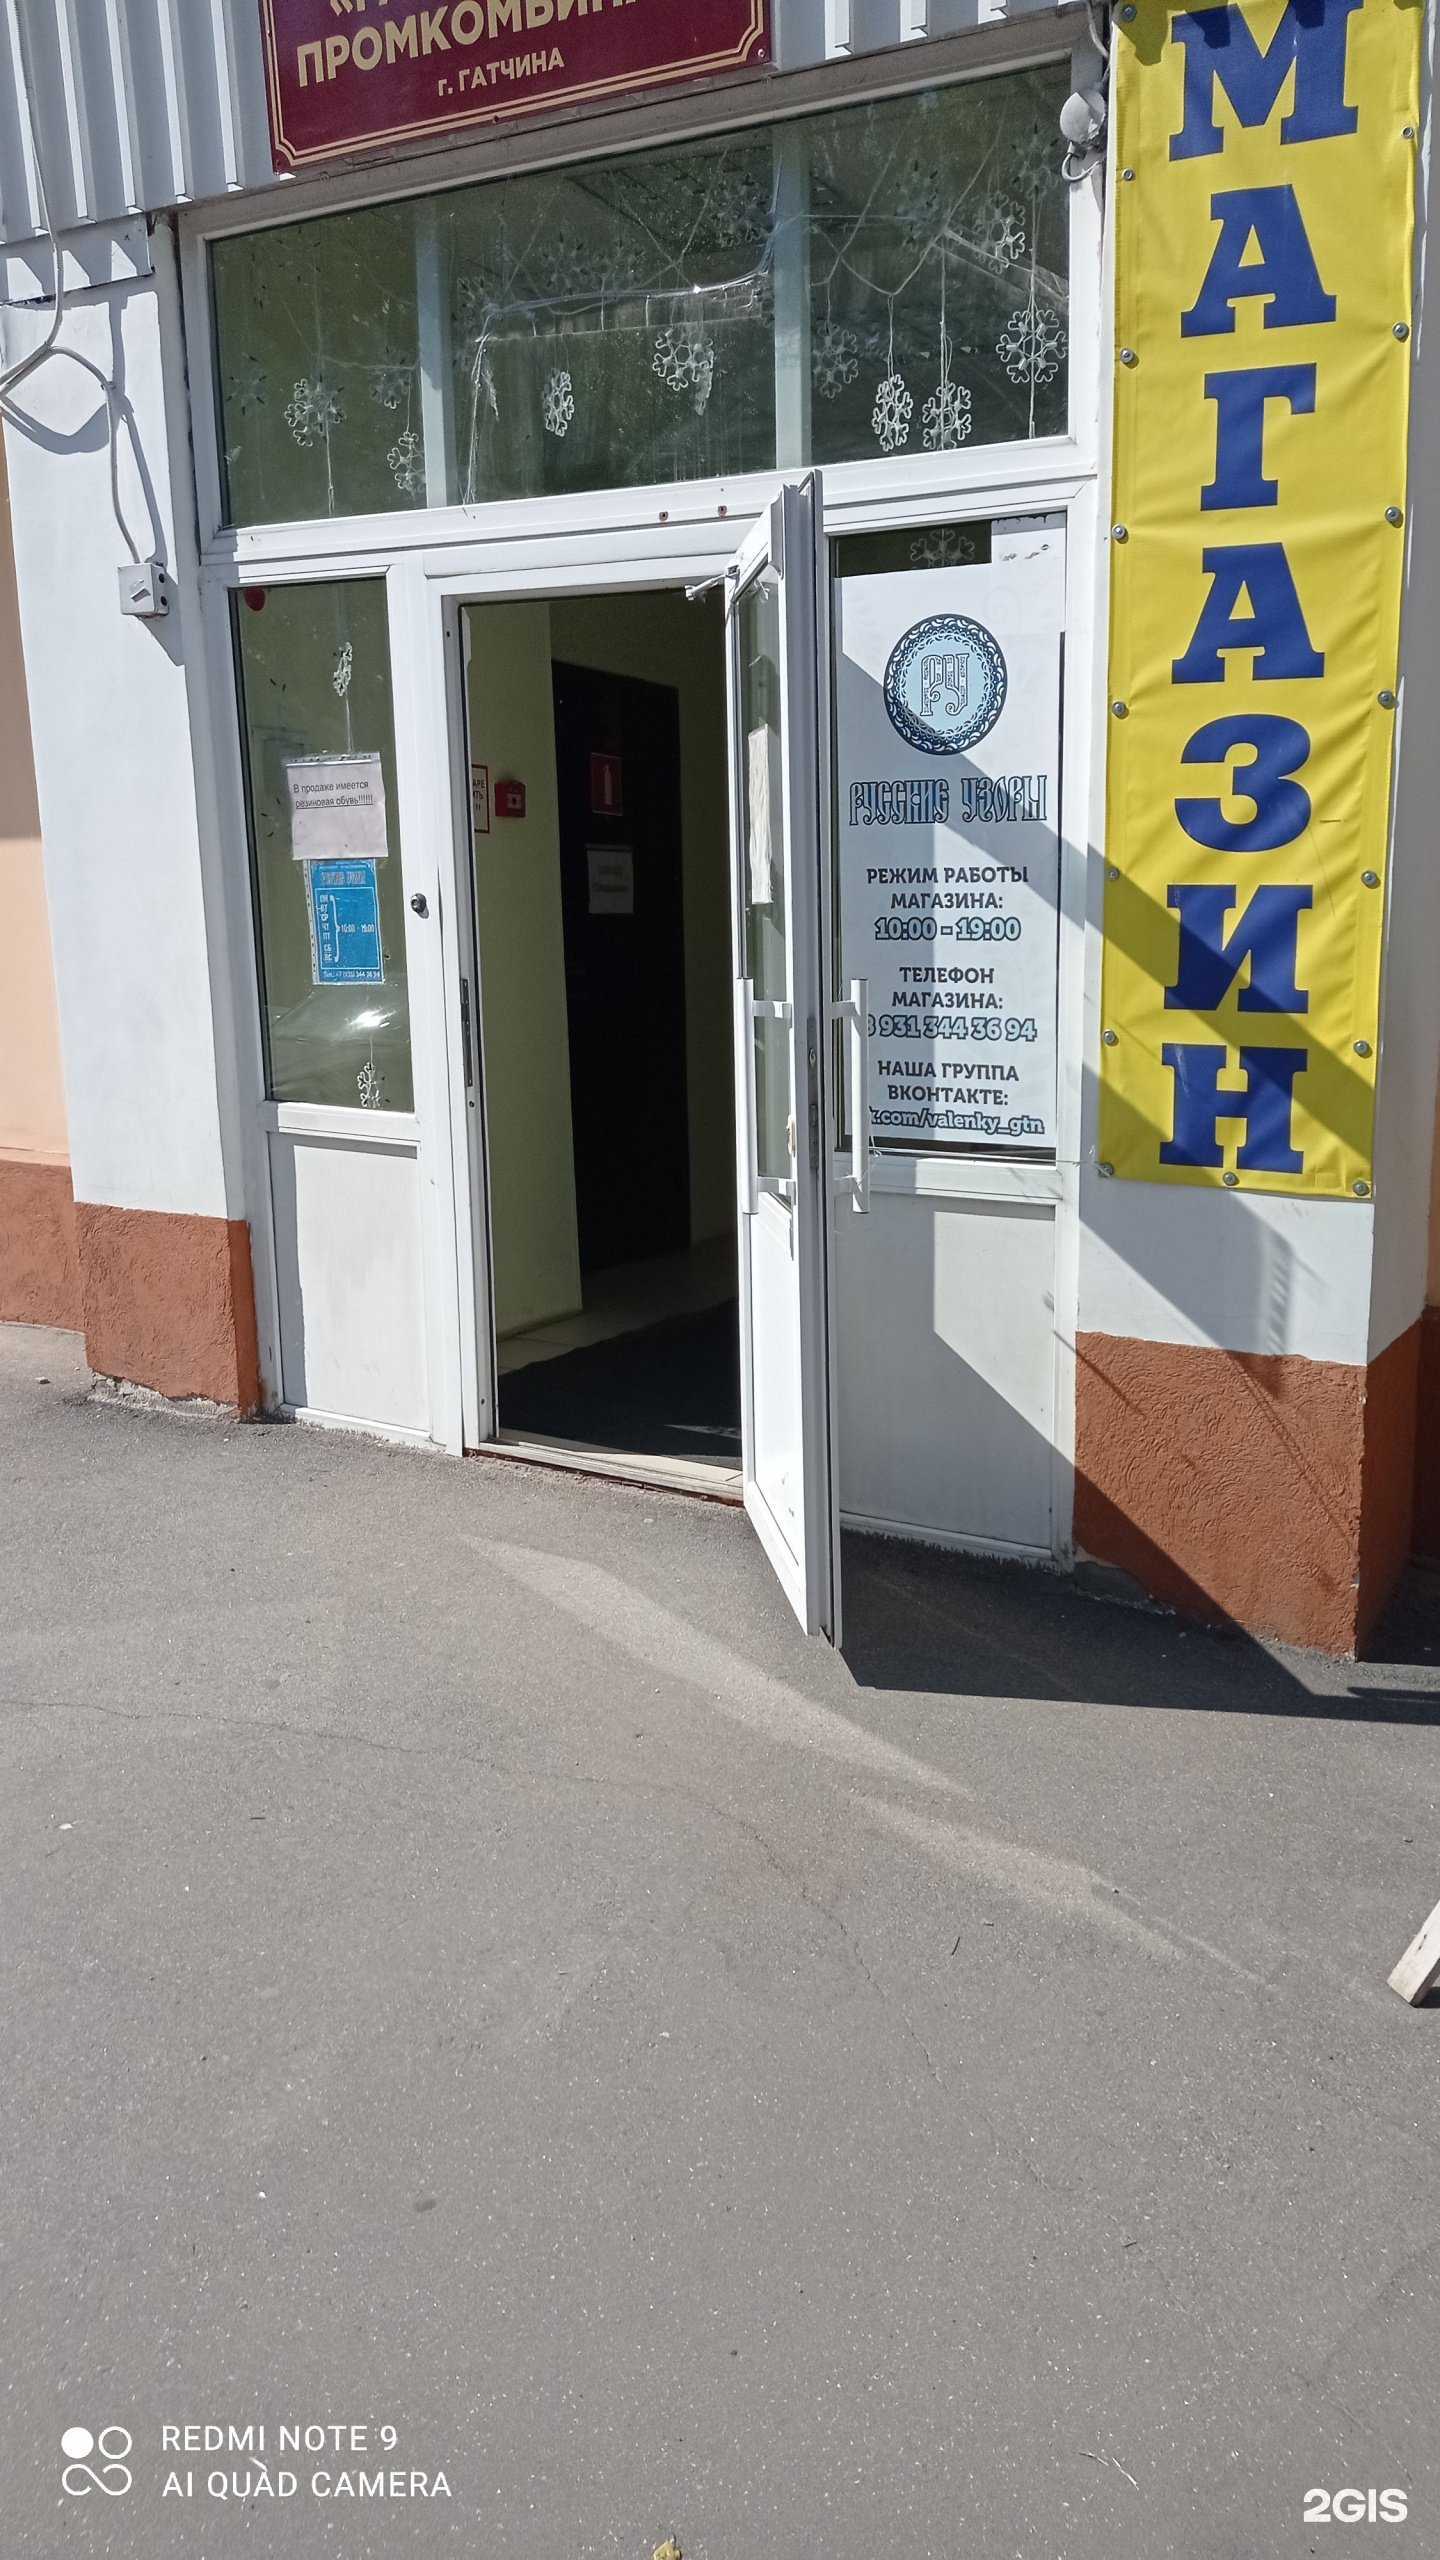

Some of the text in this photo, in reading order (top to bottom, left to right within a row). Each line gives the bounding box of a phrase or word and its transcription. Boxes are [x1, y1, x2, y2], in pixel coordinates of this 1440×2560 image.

[438, 47, 565, 97] г. ГАТЧИНА
[1159, 0, 1365, 1174] МАГАЗИН
[293, 783, 300, 793] В
[336, 781, 369, 791] имеется
[960, 774, 1048, 823] УЗОРЫ
[867, 866, 1029, 885] РЕЖИМ РАБОТЫ
[891, 893, 1003, 909] МАГАЗИНА:
[875, 917, 937, 941] 10:00
[956, 917, 1021, 941] 19:00
[900, 966, 994, 984] ТЕЛЕФОН
[892, 992, 1003, 1010] МАГАЗИНА:
[879, 1014, 921, 1038] 931
[923, 1016, 968, 1040] 344
[971, 1017, 1001, 1041] 36
[1005, 1018, 1037, 1042] 94
[878, 1060, 1019, 1082] НАША ГРУППА
[888, 1084, 1009, 1106] ВКОНТАКТЕ:
